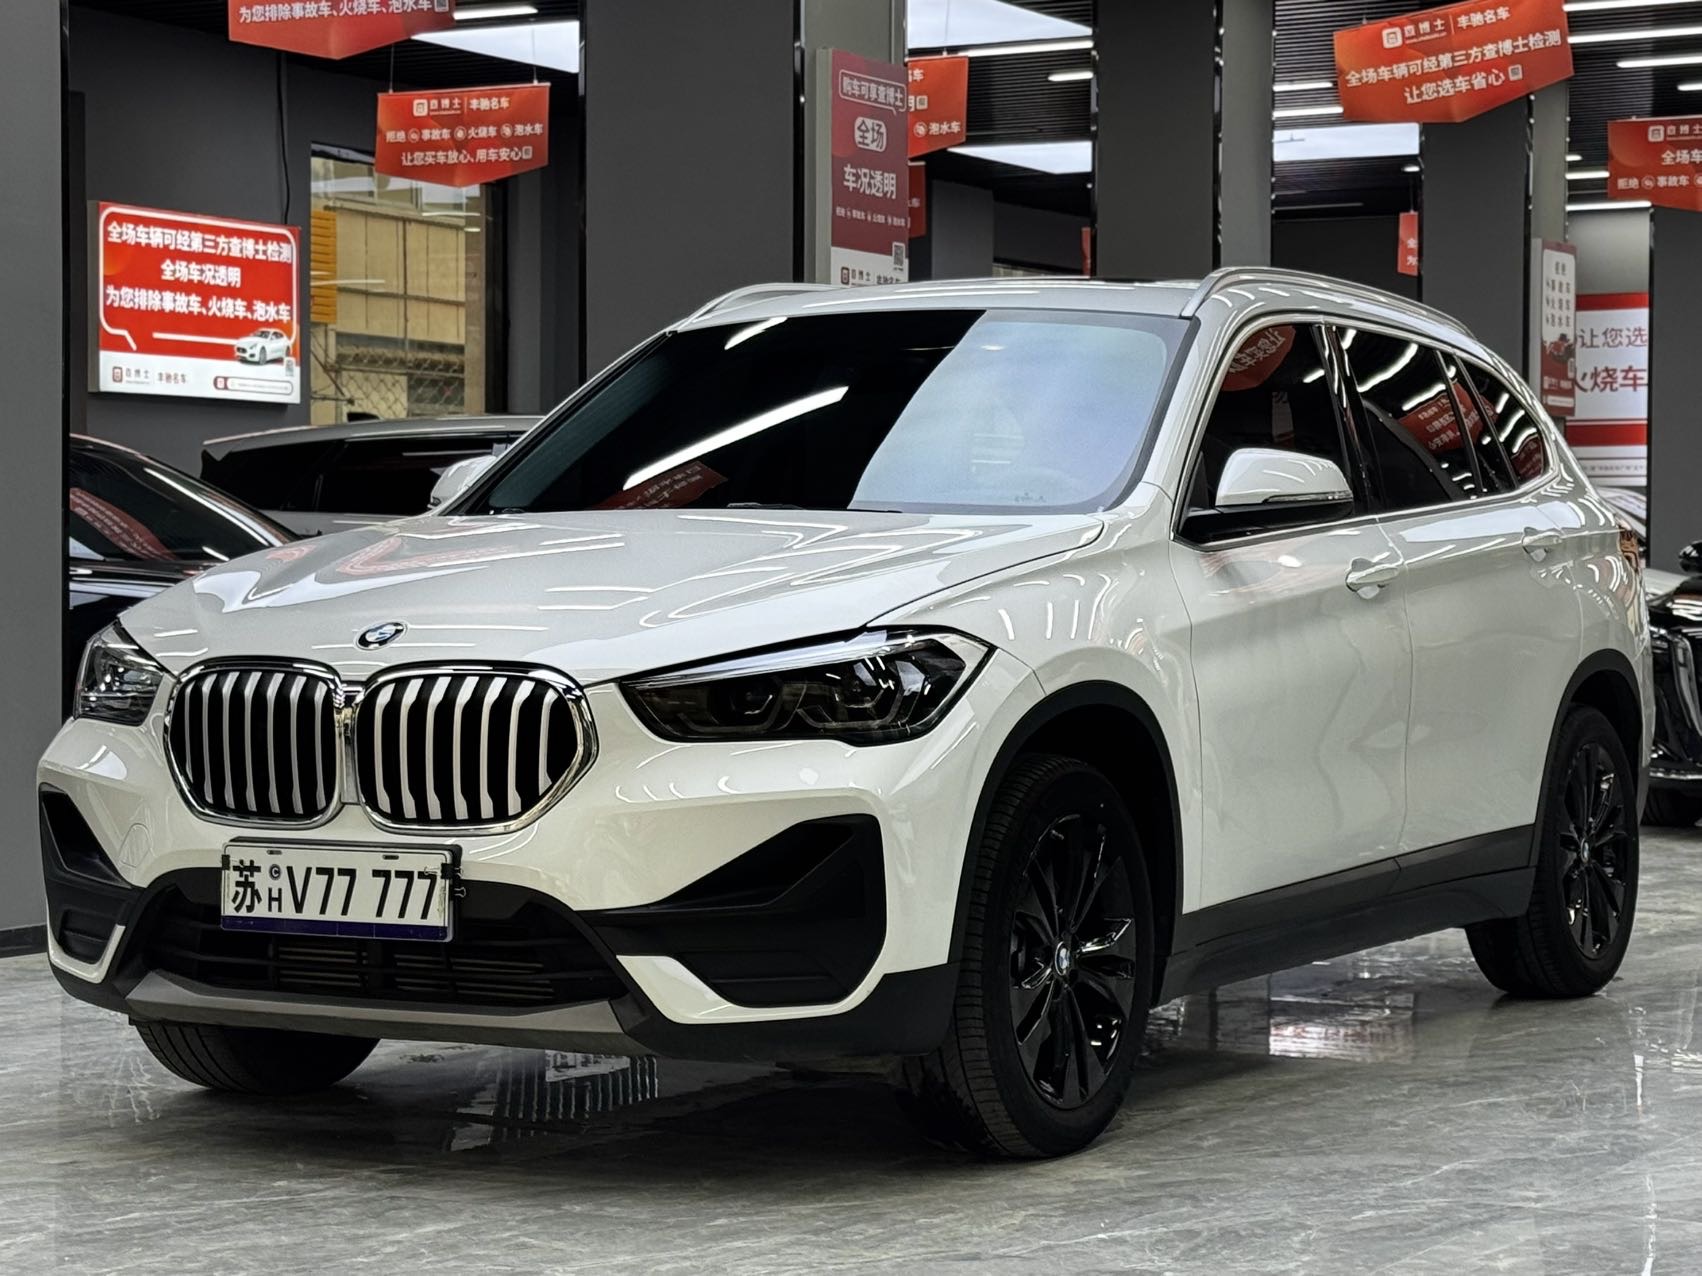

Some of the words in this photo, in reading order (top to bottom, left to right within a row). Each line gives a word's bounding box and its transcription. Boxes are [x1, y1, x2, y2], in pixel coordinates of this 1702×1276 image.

[1346, 29, 1562, 88] 全场车辆可经第三方查博士检测
[1404, 68, 1505, 104] 让您选车省心
[856, 119, 885, 150] 全场
[402, 146, 522, 166] 让您买车放心、用车安心
[842, 164, 897, 199] 车况透明
[107, 221, 292, 263] 全场车辆可经第三方查博士检测
[161, 259, 241, 288] 全场车况透明
[106, 285, 291, 323] 为您排除事故车、火烧车、泡水车
[1577, 327, 1648, 348] 让您选
[231, 859, 262, 913] 苏
[267, 887, 283, 912] H
[286, 866, 357, 916] V77
[372, 869, 438, 920] 777
